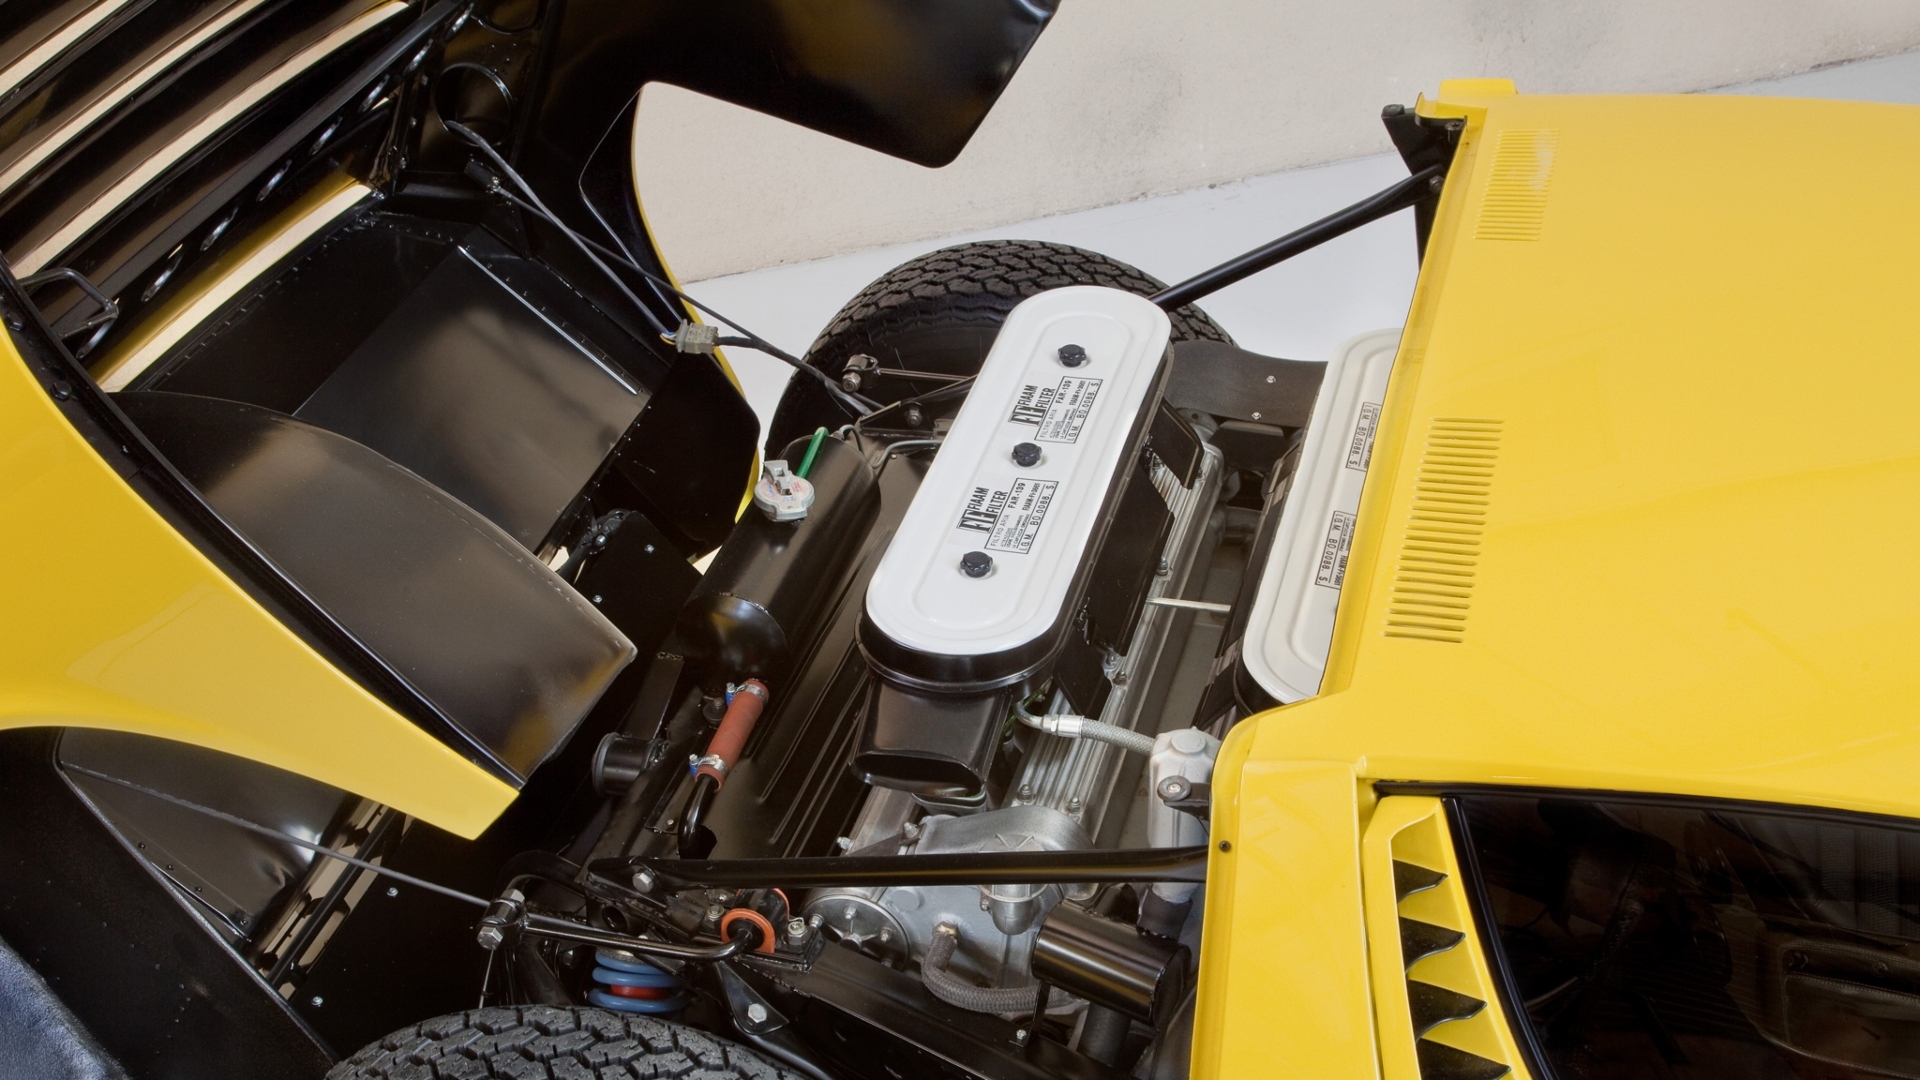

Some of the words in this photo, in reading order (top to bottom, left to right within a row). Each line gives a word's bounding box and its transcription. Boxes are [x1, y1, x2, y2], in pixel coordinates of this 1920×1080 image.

[1017, 385, 1038, 406] FIAAM
[1035, 388, 1055, 408] FILTER
[1039, 420, 1053, 438] FILTRO
[967, 488, 989, 510] FIAAM
[986, 491, 1008, 513] FILTER
[989, 527, 1004, 546] FILTRO
